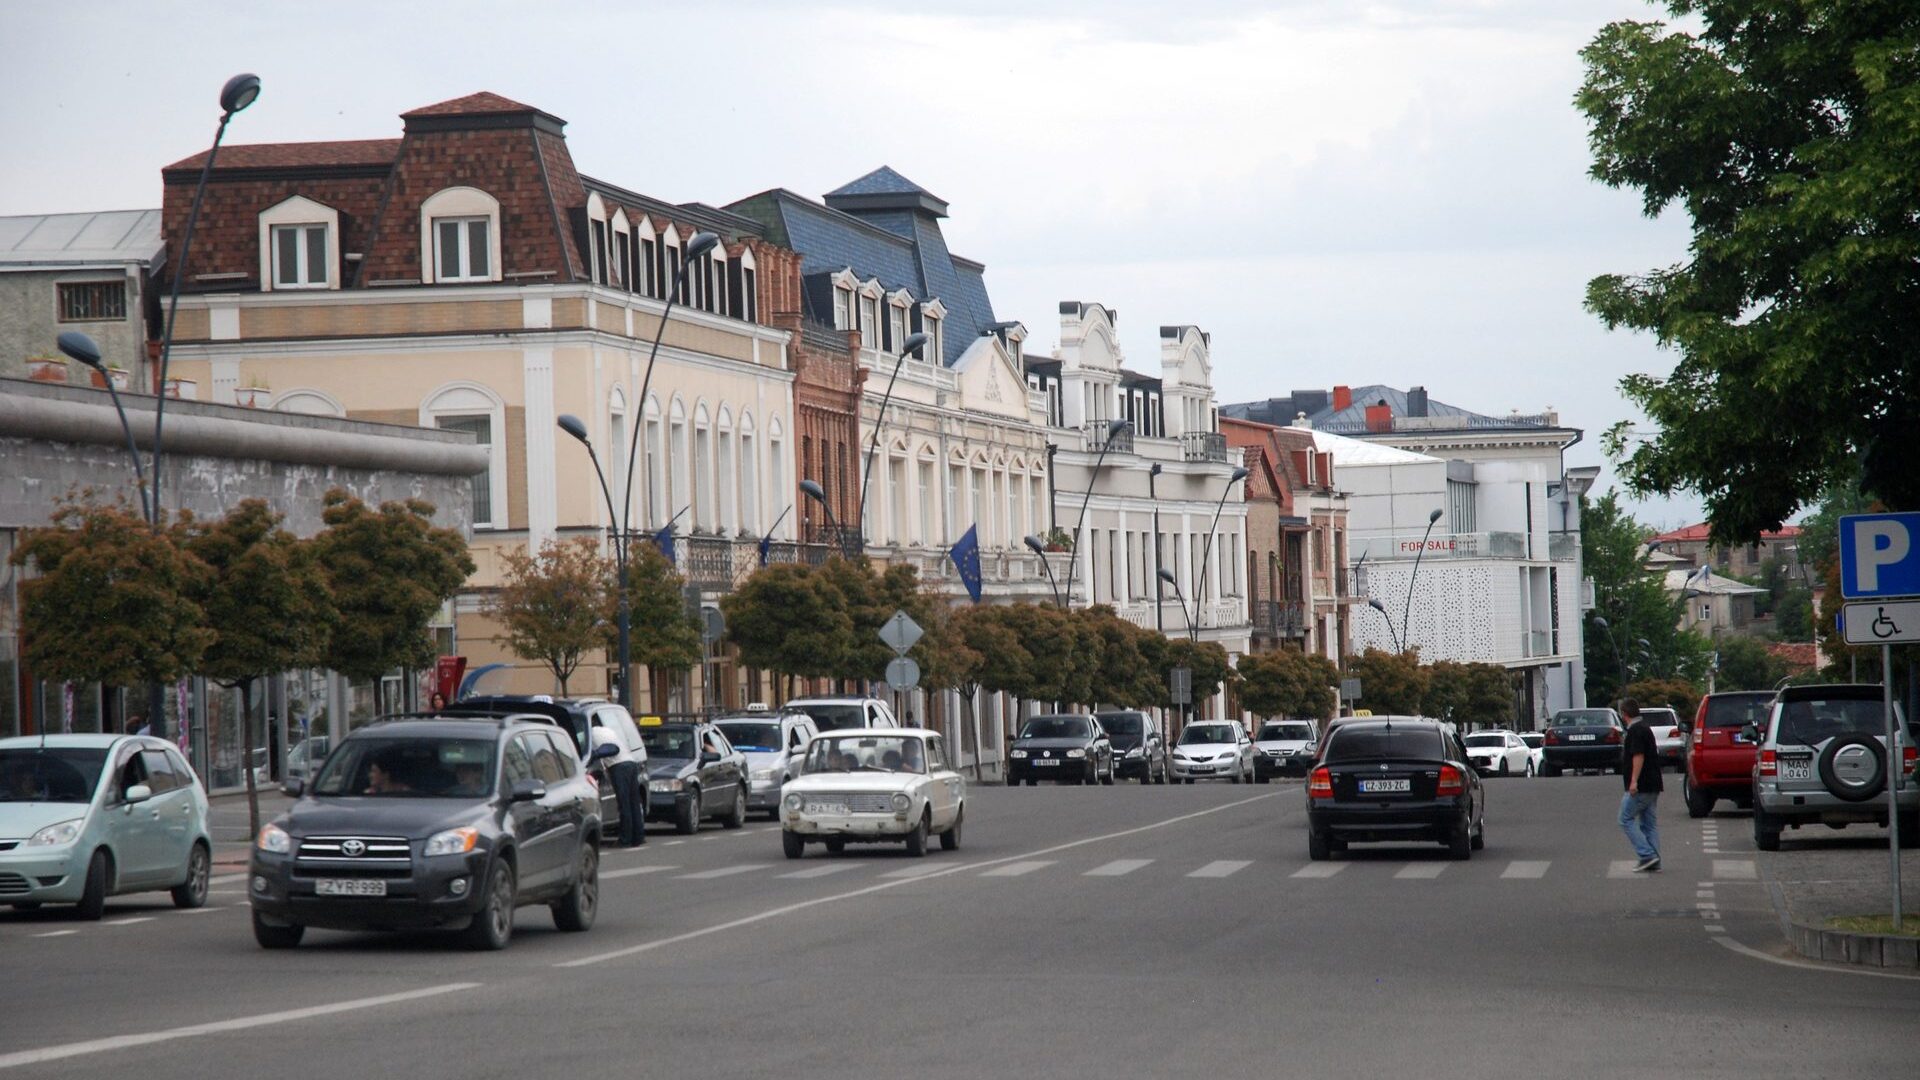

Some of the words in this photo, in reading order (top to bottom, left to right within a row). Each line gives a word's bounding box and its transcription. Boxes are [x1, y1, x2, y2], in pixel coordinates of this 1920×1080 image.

[1401, 541, 1423, 552] FOR
[1427, 540, 1456, 551] SALE
[1854, 519, 1910, 592] P
[1789, 769, 1808, 778] 040
